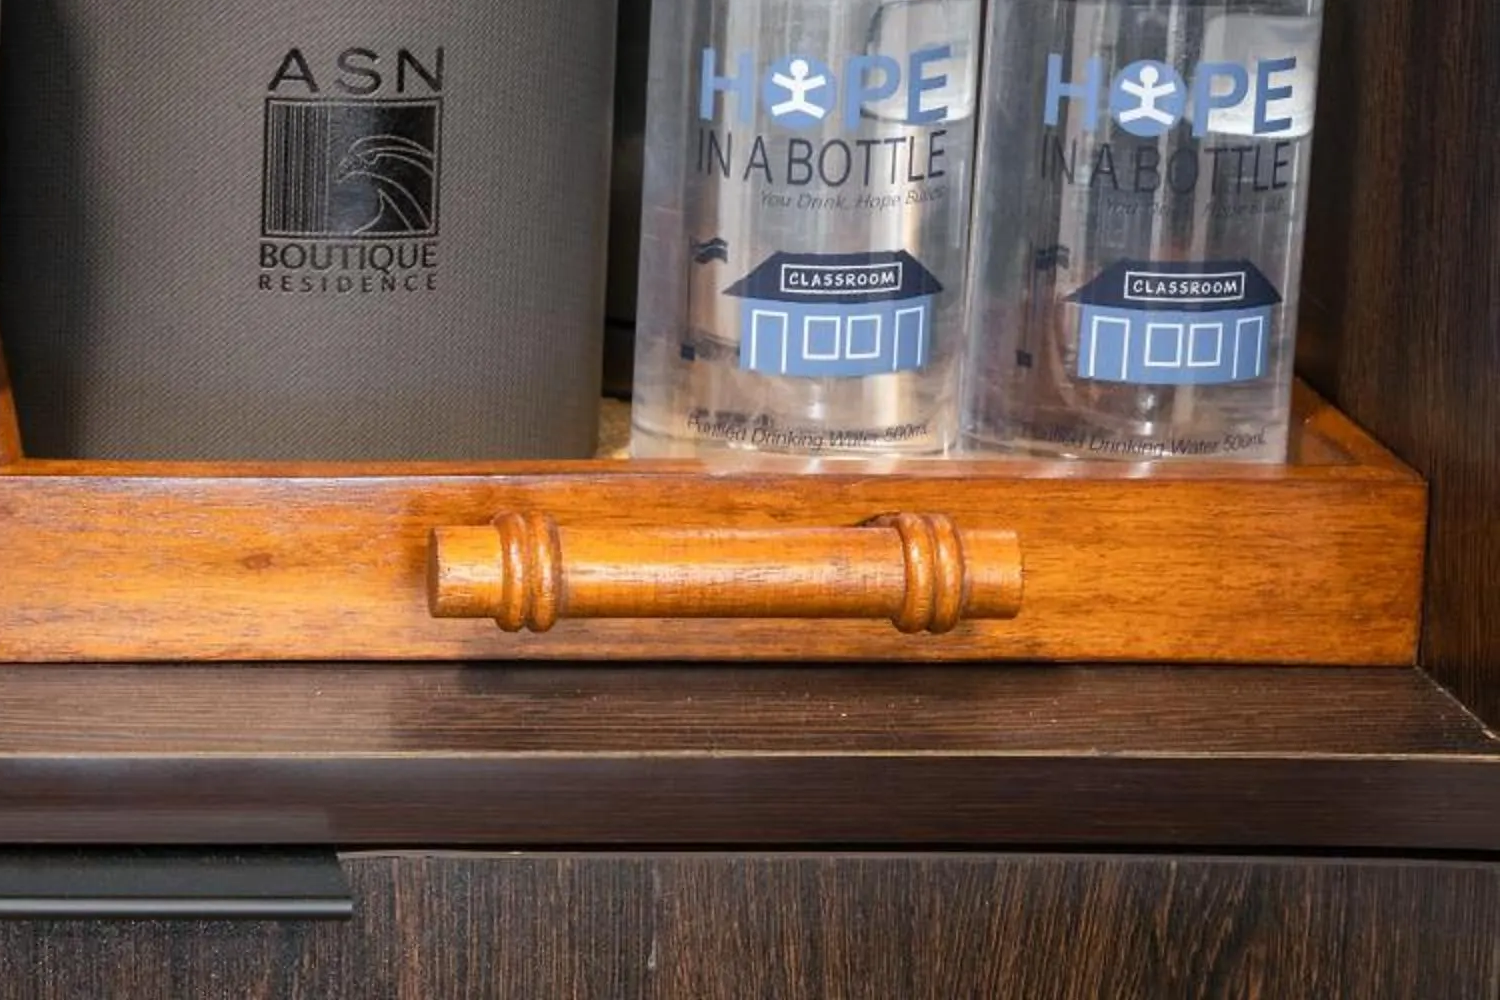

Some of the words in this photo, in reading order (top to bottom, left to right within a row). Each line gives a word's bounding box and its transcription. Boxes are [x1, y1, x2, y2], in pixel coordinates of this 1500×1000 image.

[267, 47, 445, 95] ASN
[699, 44, 952, 130] HOPE
[1043, 53, 1297, 138] HOPE
[697, 129, 731, 179] IN
[743, 137, 774, 184] A
[786, 129, 947, 187] BOTTLE
[1040, 133, 1076, 186] IN
[1090, 141, 1119, 192] A
[1132, 141, 1291, 195] BOTTLE
[259, 242, 438, 273] BOUTIQUE
[259, 274, 438, 293] RESIDENCE
[788, 270, 897, 288] CLASSROOM
[1132, 279, 1239, 297] CLASSROOM
[750, 426, 824, 452] Drinking
